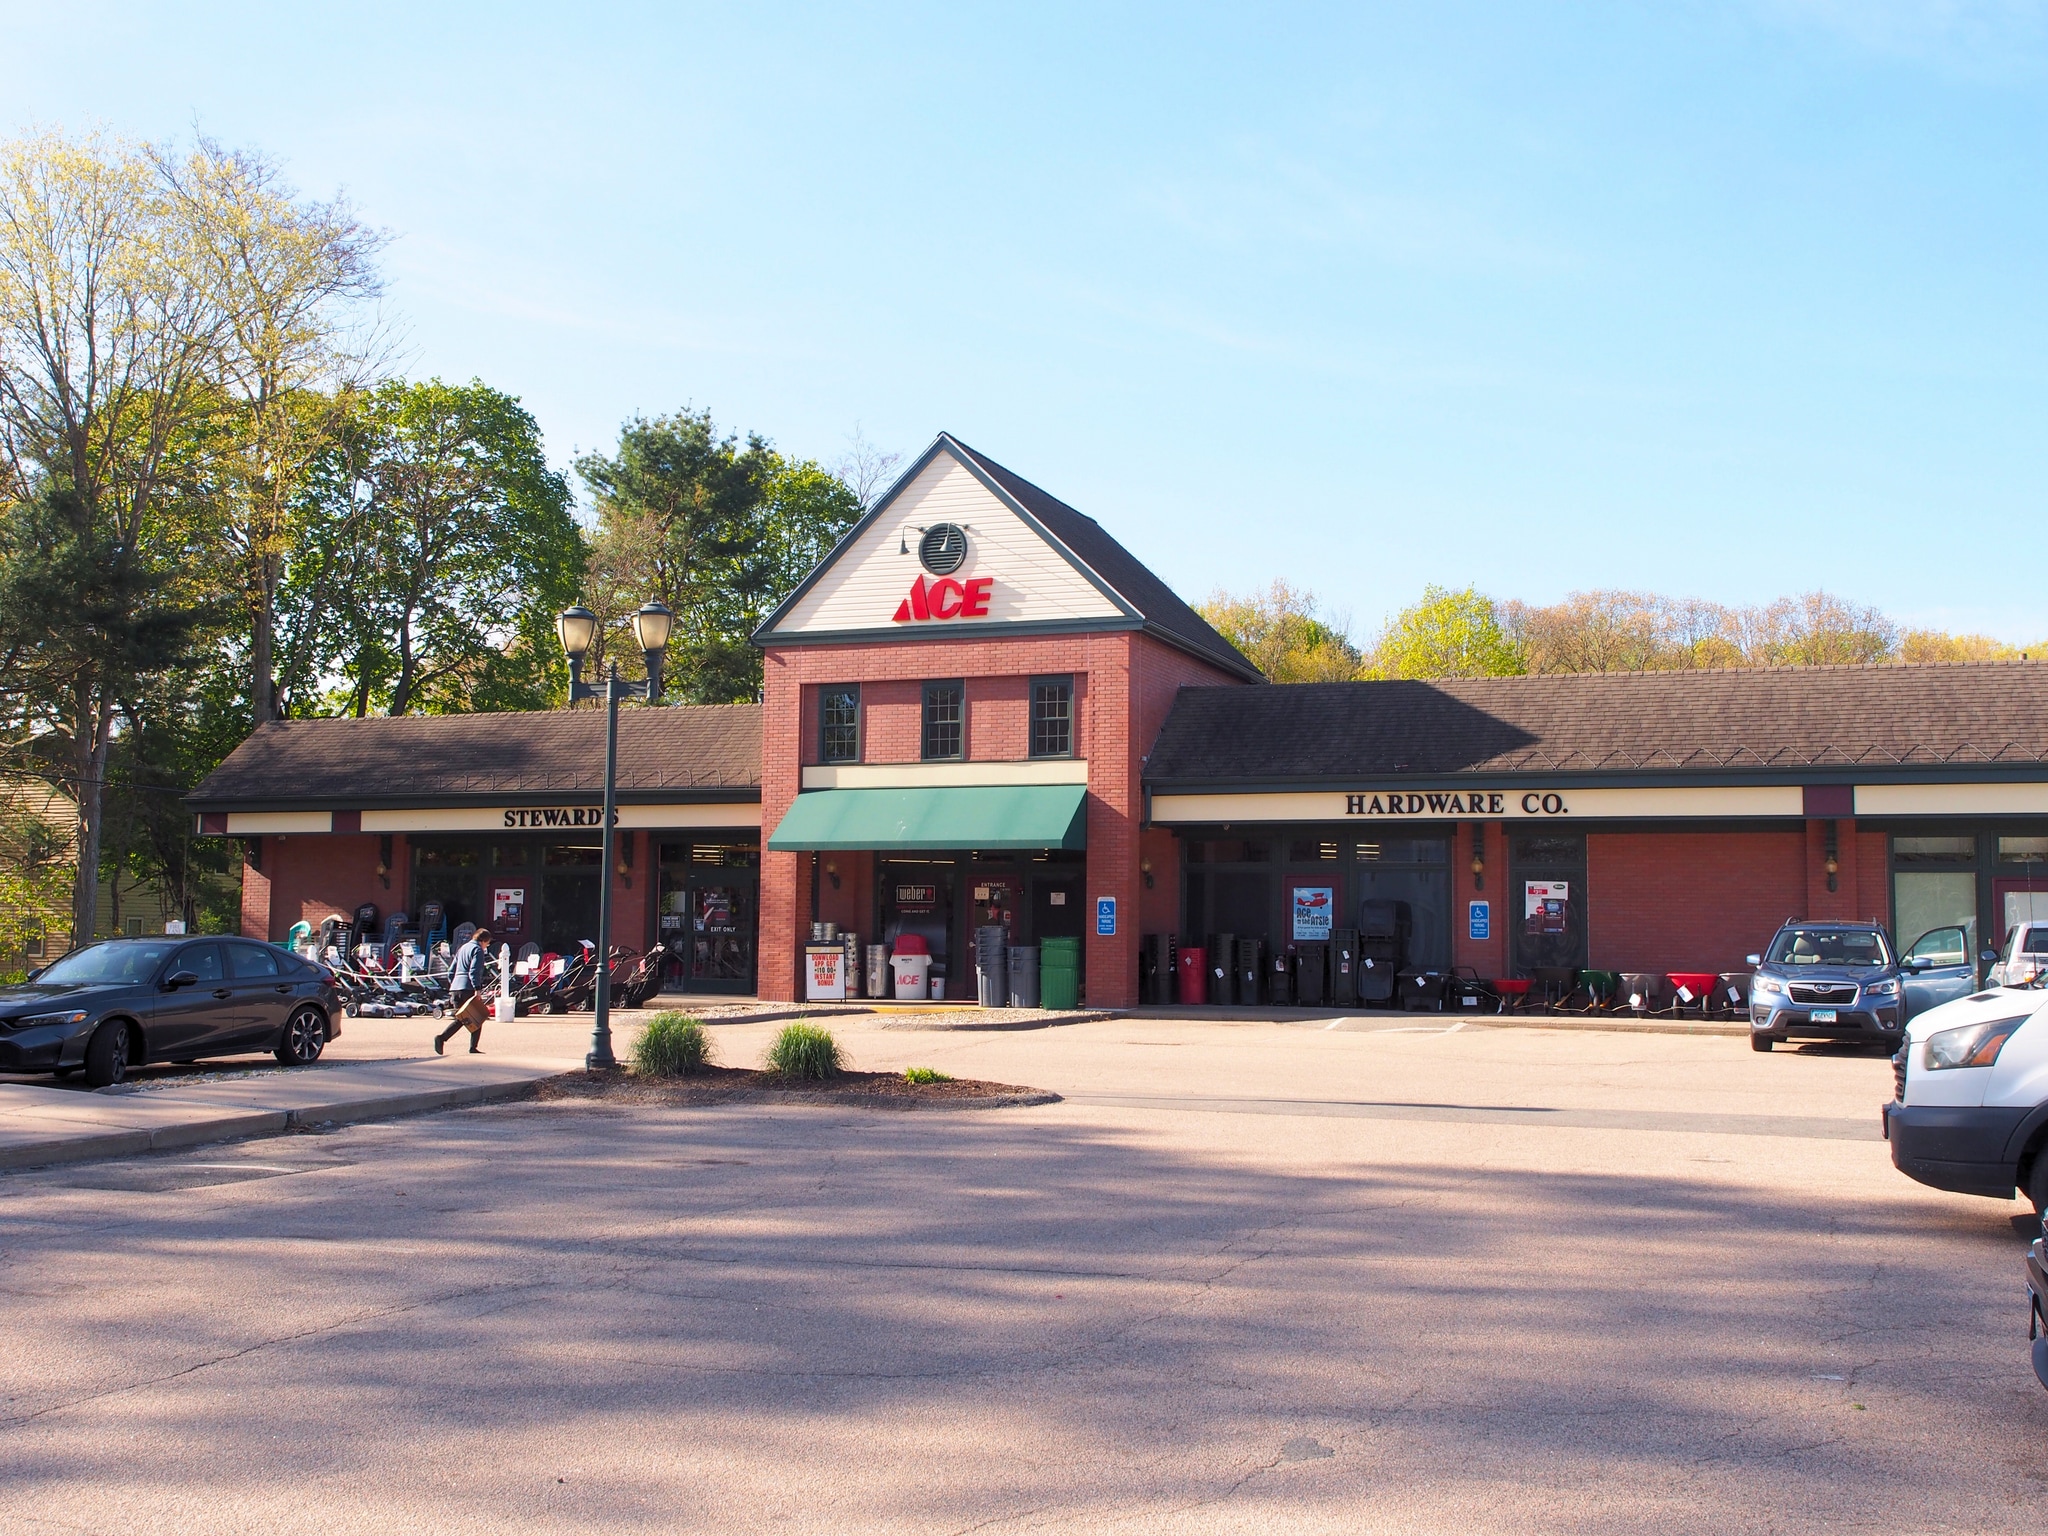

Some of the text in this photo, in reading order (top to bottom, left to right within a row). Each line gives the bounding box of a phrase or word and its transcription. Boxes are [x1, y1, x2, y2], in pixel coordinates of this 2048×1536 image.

[892, 573, 993, 621] ACE
[1345, 793, 1568, 815] HARDWARE CO.
[899, 886, 925, 900] weber
[897, 974, 919, 985] ACE
